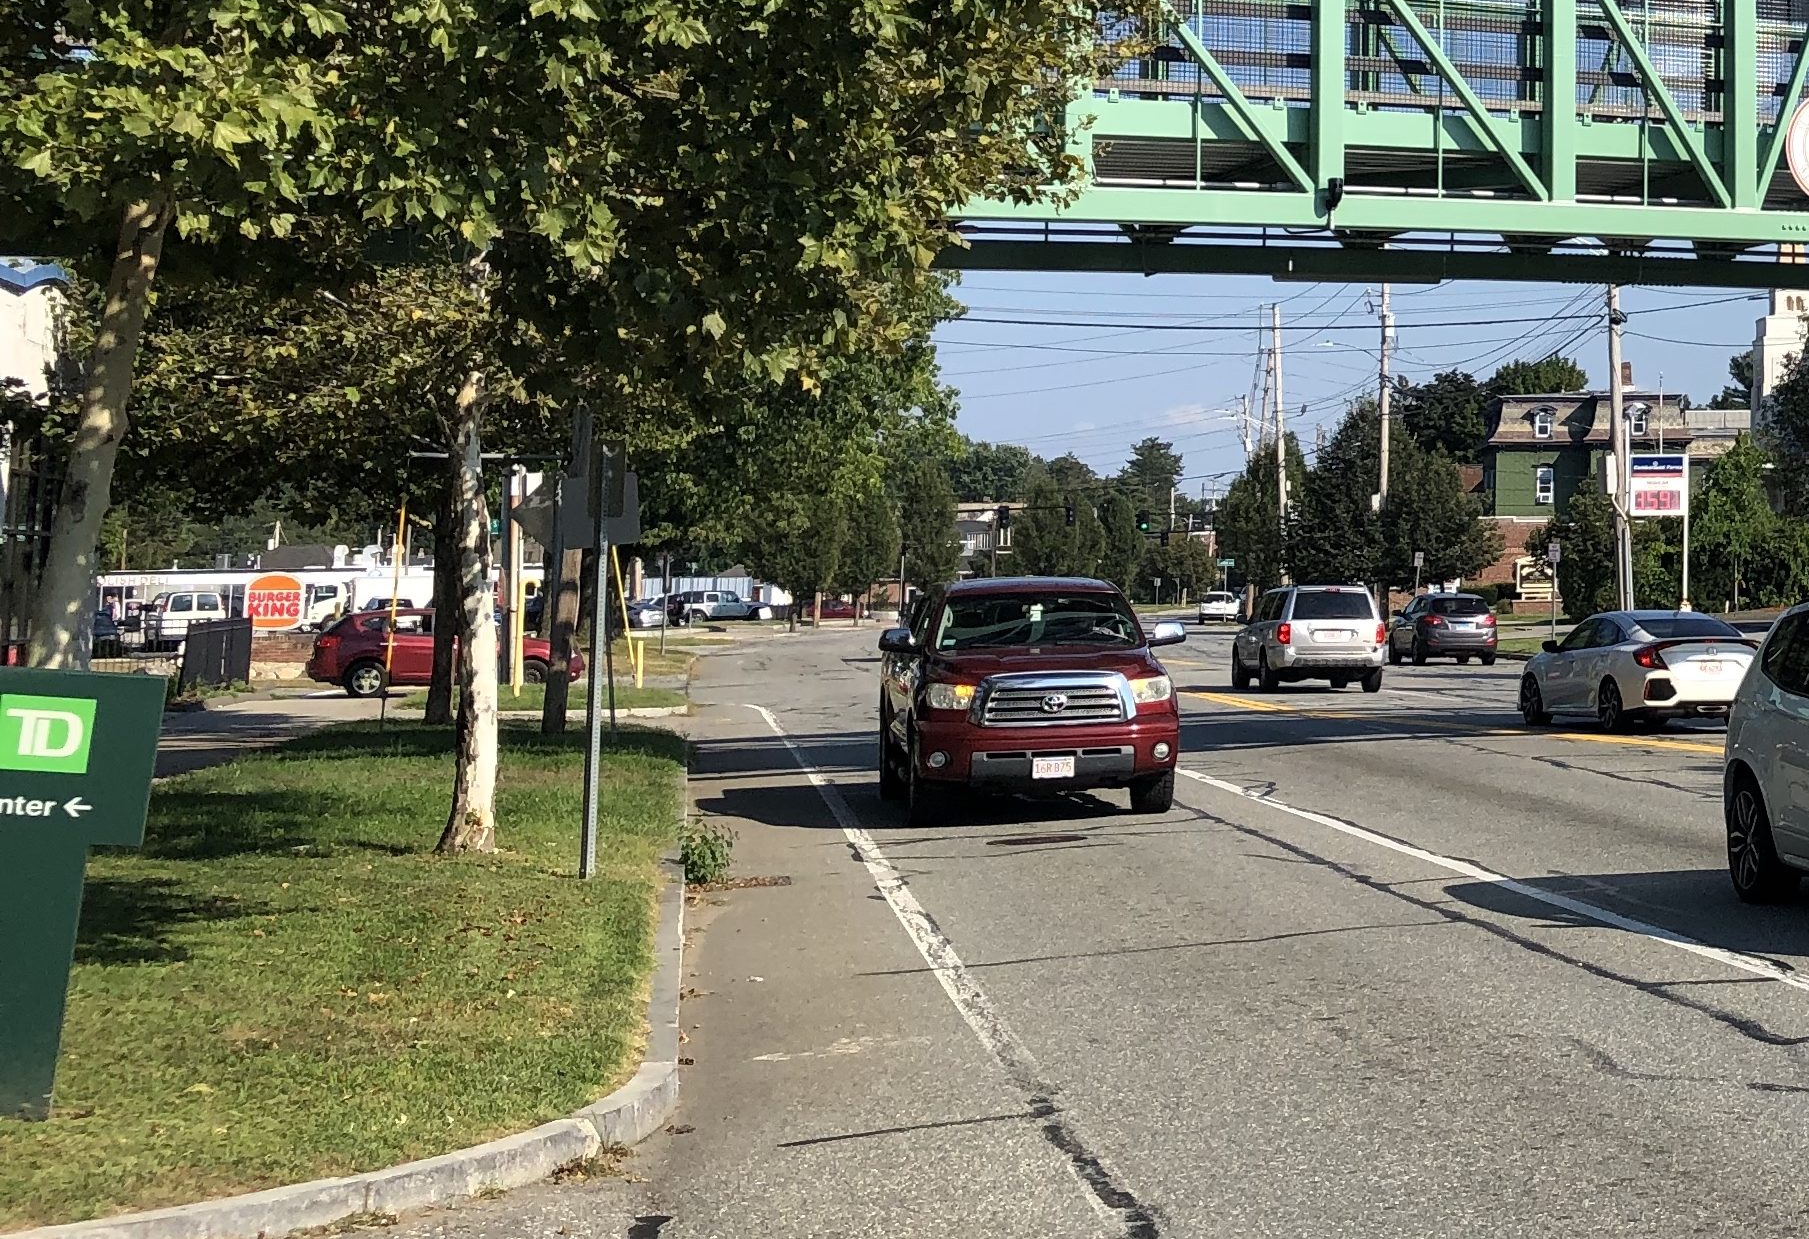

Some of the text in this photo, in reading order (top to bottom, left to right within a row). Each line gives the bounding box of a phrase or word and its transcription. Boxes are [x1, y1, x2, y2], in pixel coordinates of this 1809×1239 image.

[249, 592, 301, 603] BURGER
[248, 602, 300, 618] KING
[6, 708, 84, 758] TD
